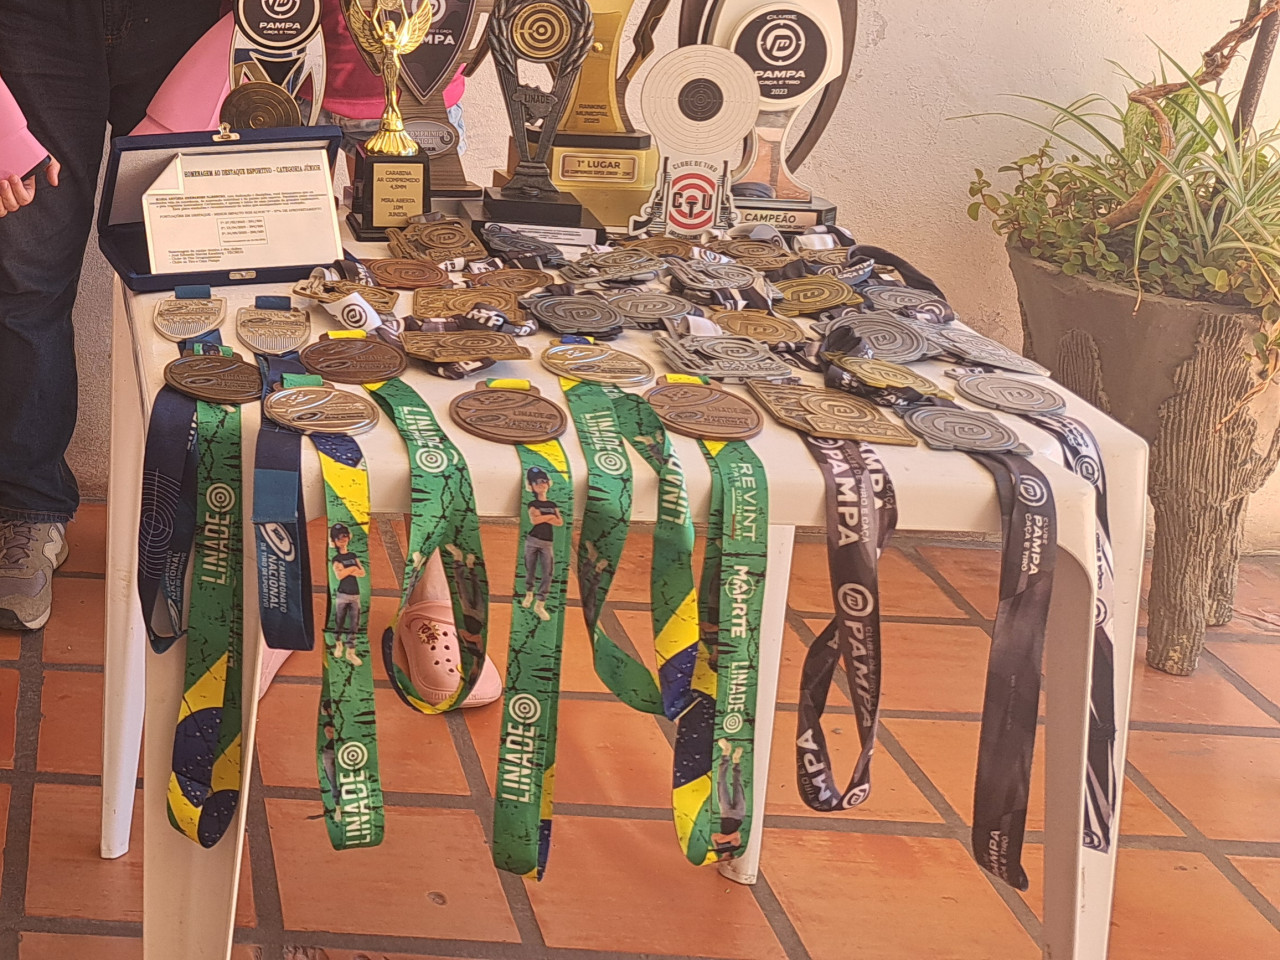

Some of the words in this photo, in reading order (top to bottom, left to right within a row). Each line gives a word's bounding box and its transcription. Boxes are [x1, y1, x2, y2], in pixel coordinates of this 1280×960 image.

[754, 70, 806, 78] PAMPA
[184, 170, 213, 178] HOMENAGEM
[222, 169, 246, 177] DESTAQUE
[246, 167, 272, 175] ESPORTIVO
[276, 165, 303, 173] CATEGORIA
[587, 161, 621, 169] LUGAR
[744, 212, 797, 223] CAMPEÃO
[402, 406, 444, 450] LINADE
[584, 411, 622, 452] LINADE
[730, 463, 741, 488] STATE
[820, 449, 860, 547] PAMPA
[858, 484, 867, 507] TIRO
[738, 463, 758, 541] REVINT
[1024, 513, 1033, 535] CAÇA
[201, 512, 232, 585] LINADE
[861, 517, 870, 543] CAÇA
[1028, 515, 1043, 575] PAMPA
[170, 551, 181, 600] NACIONAL
[268, 554, 277, 609] NACIONAL
[1021, 549, 1029, 572] TIRO
[279, 560, 287, 614] CAMPEONATO
[728, 661, 749, 712] LINADE
[844, 620, 870, 728] PAMPA
[501, 722, 535, 803] LINADE
[339, 770, 370, 845] LINADE
